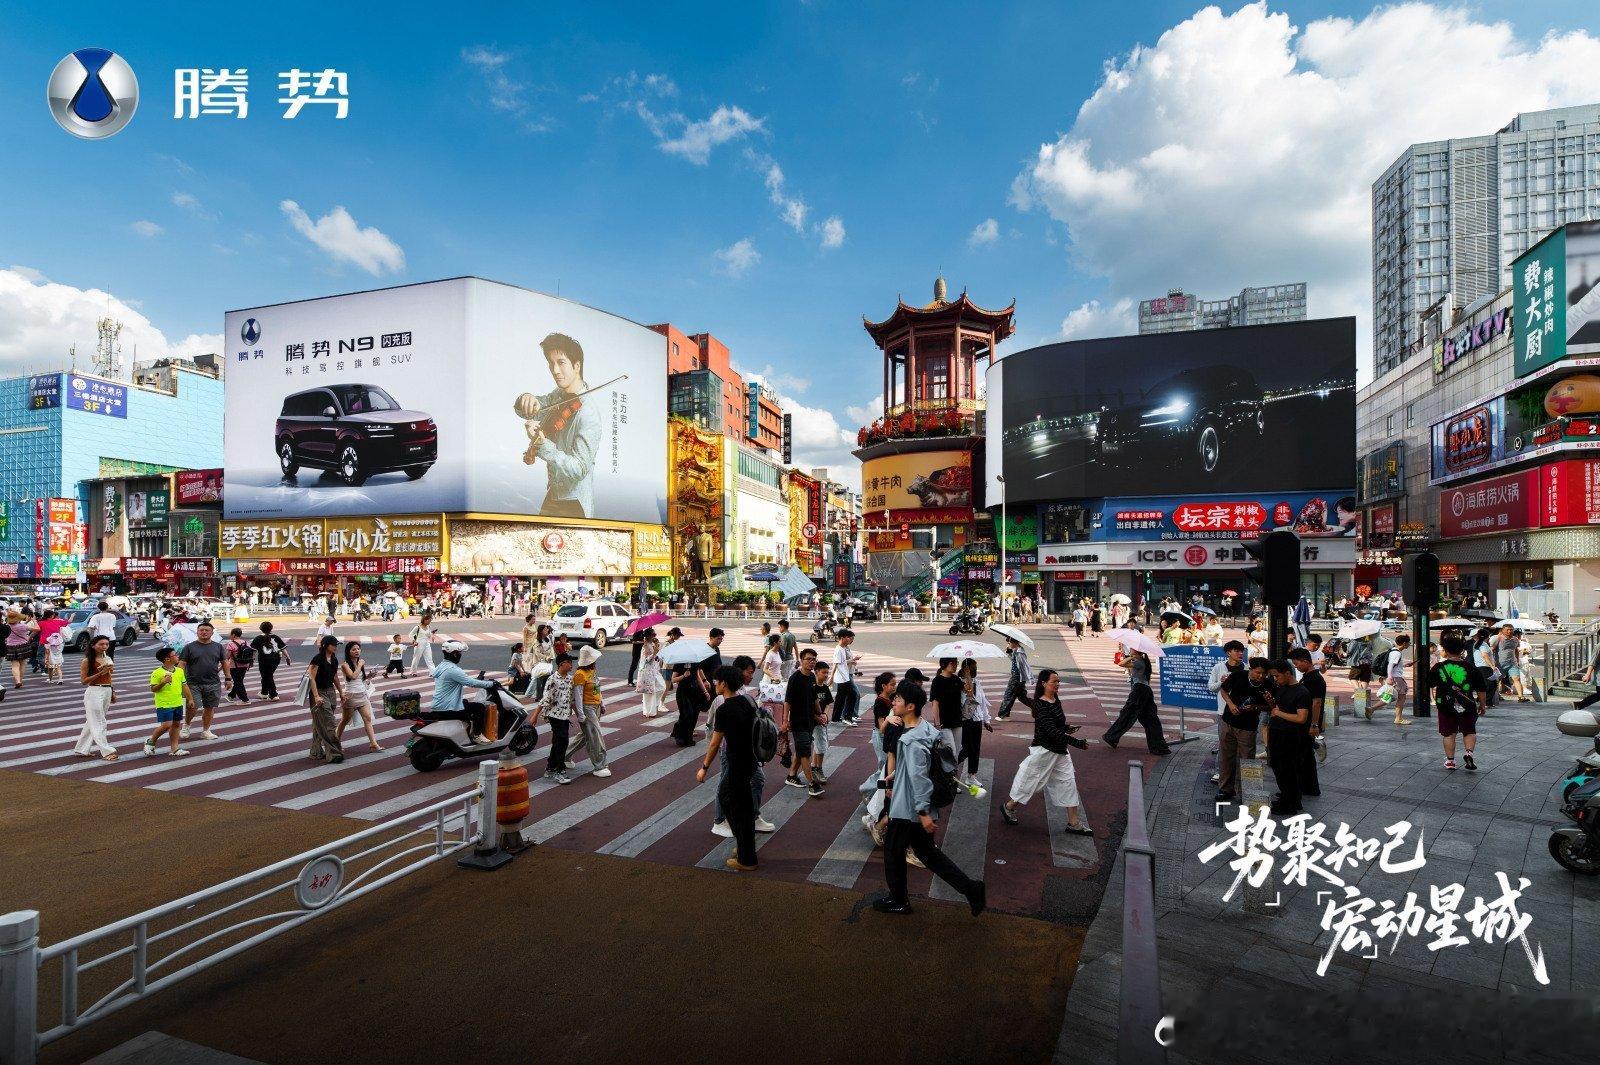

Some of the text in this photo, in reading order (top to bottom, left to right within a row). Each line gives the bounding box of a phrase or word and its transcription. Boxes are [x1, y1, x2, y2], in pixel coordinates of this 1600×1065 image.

[1524, 259, 1543, 362] 费大厨
[1543, 267, 1554, 335] 辣椒炒肉
[237, 350, 264, 361] 腾势
[285, 336, 374, 362] 腾势 N9
[285, 353, 412, 376] 科技驾控旗舰 SUV
[35, 397, 44, 408] 3F
[84, 401, 100, 411] 3F
[620, 393, 628, 424] 王力宏
[1466, 482, 1519, 510] 海底捞火锅
[105, 486, 115, 533] 费大厨
[1179, 505, 1230, 528] 坛宗
[1233, 504, 1259, 516] 剁椒
[1275, 504, 1291, 523] 非遗
[222, 524, 323, 551] 季季红火锅
[328, 520, 391, 554] 虾小龙
[335, 561, 365, 572] 金湘权
[1138, 550, 1178, 562] ICBC
[1192, 646, 1211, 655] 公告
